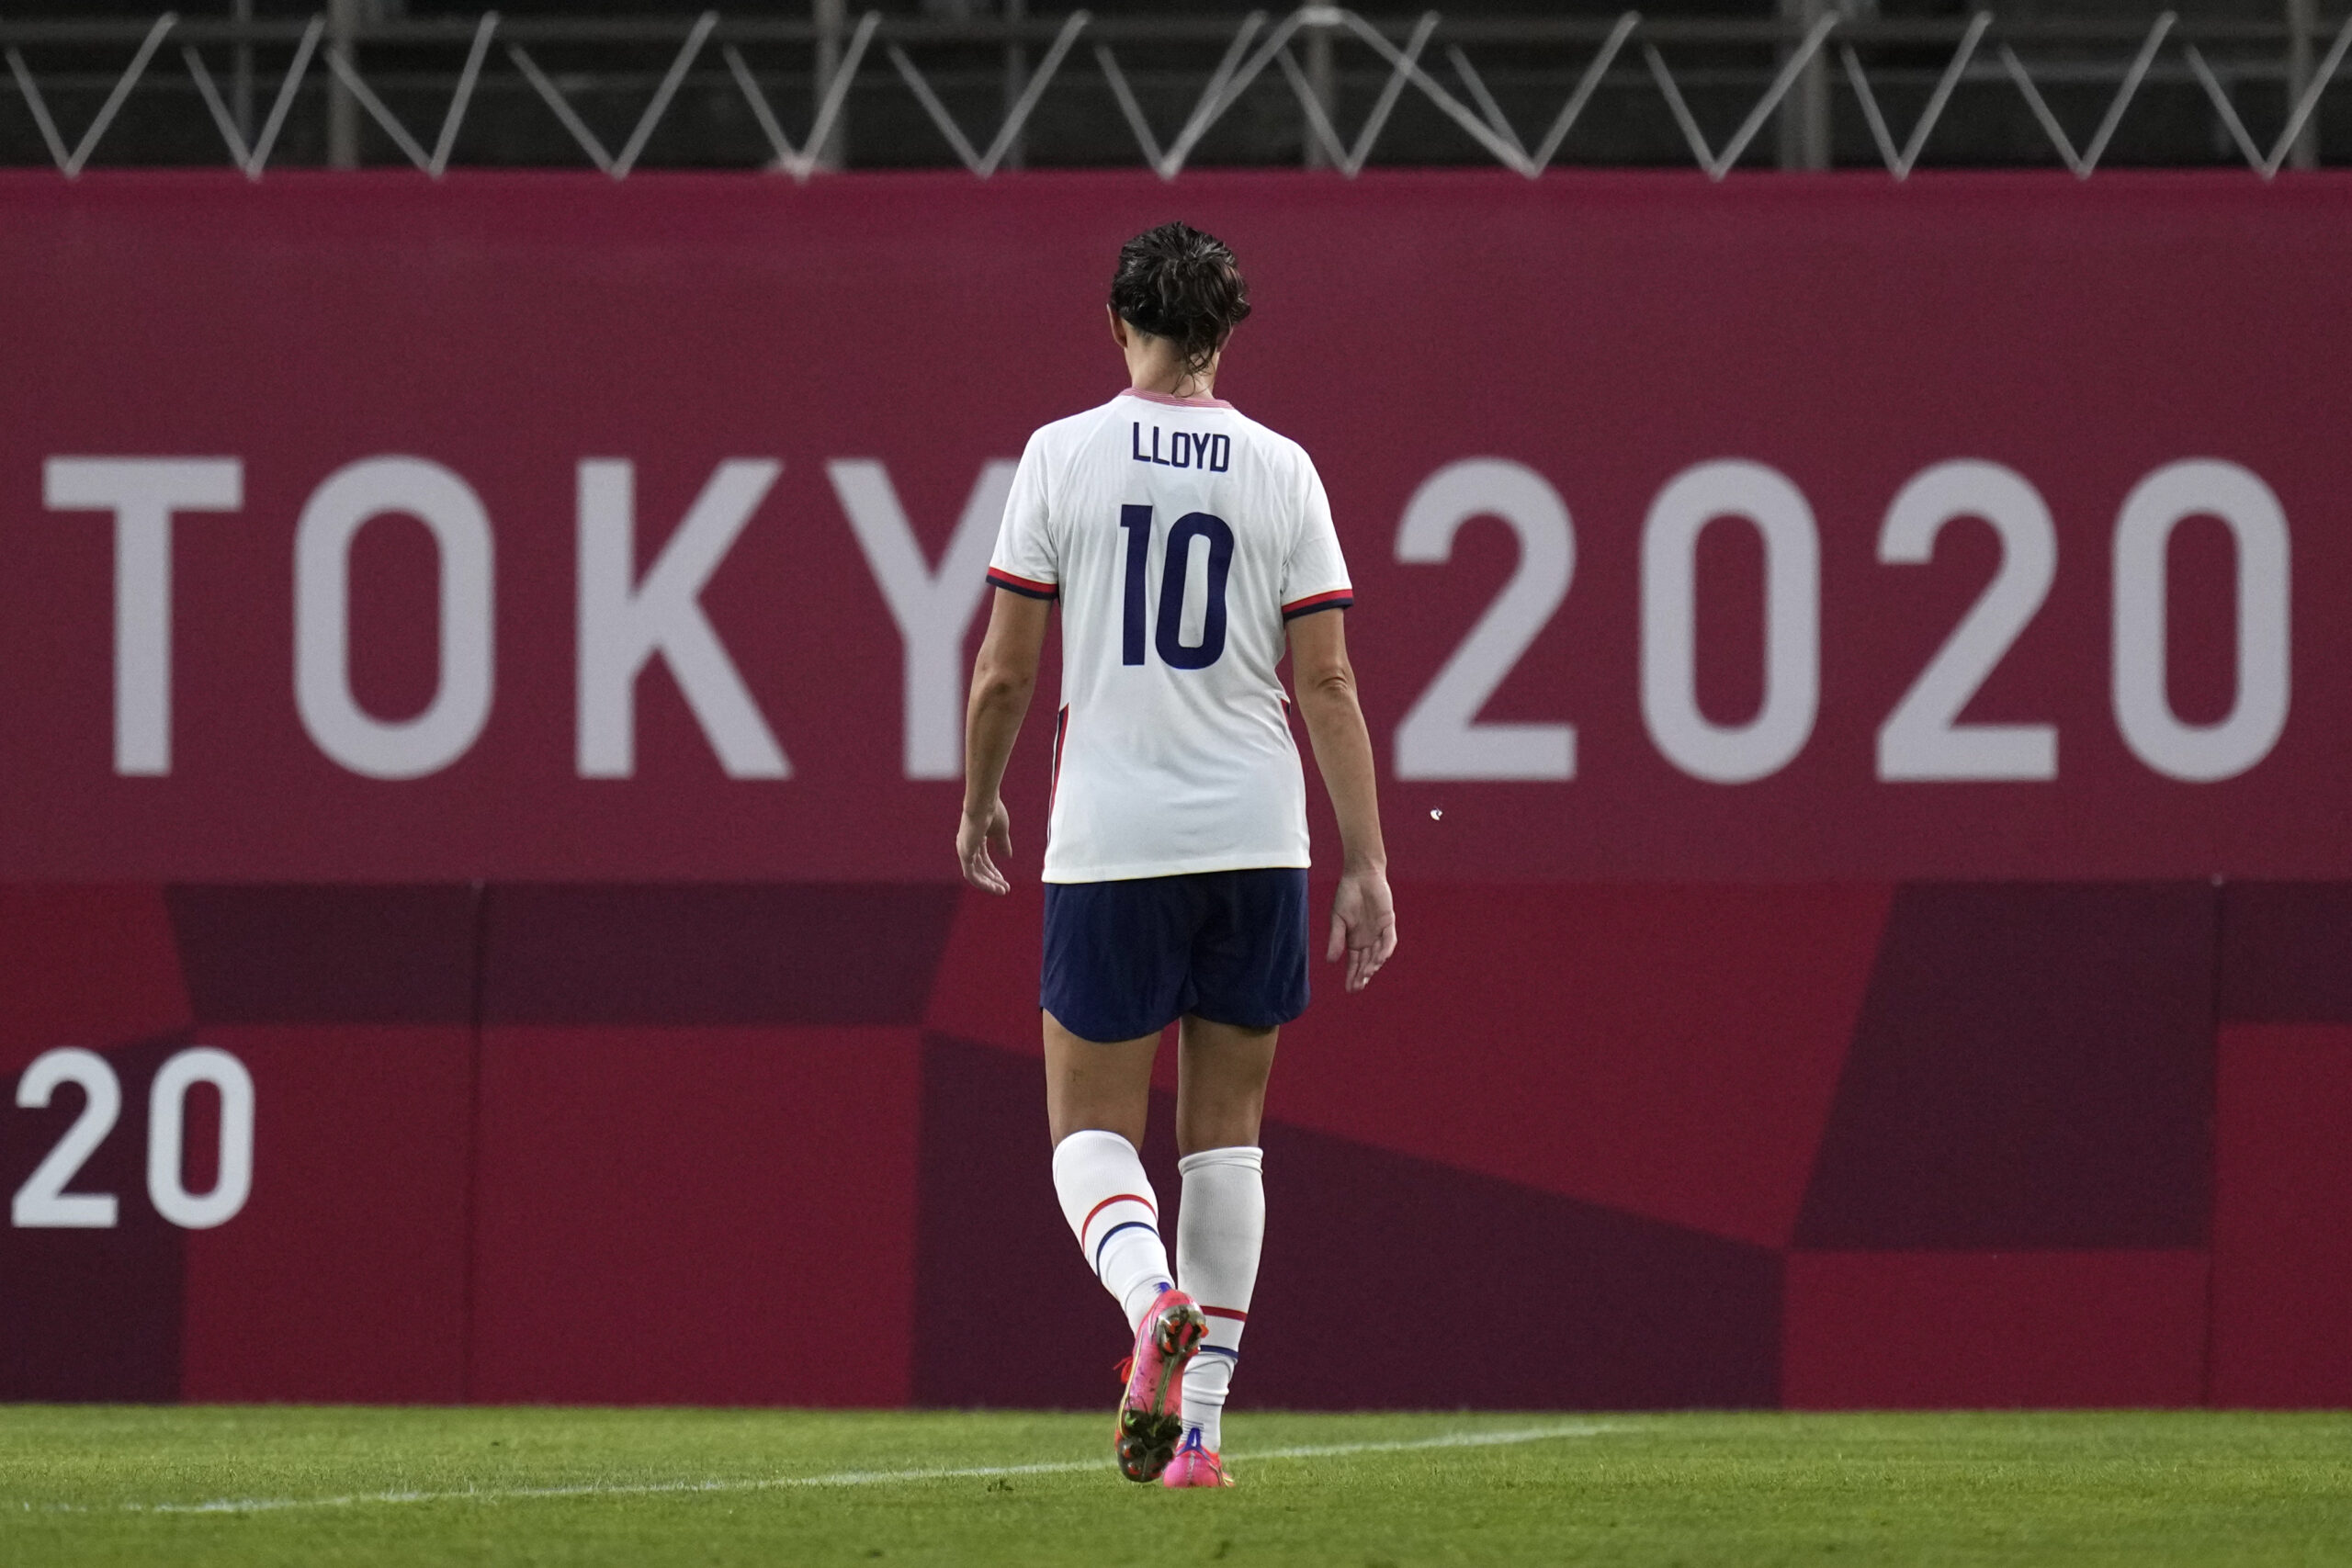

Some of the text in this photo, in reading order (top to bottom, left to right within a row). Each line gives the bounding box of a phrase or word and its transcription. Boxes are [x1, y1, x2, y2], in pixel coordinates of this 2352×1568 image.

[1133, 422, 1230, 472] LLOYD
[44, 457, 2291, 783] TOKY 2020
[1120, 504, 1235, 670] 10
[12, 1047, 255, 1229] 20
